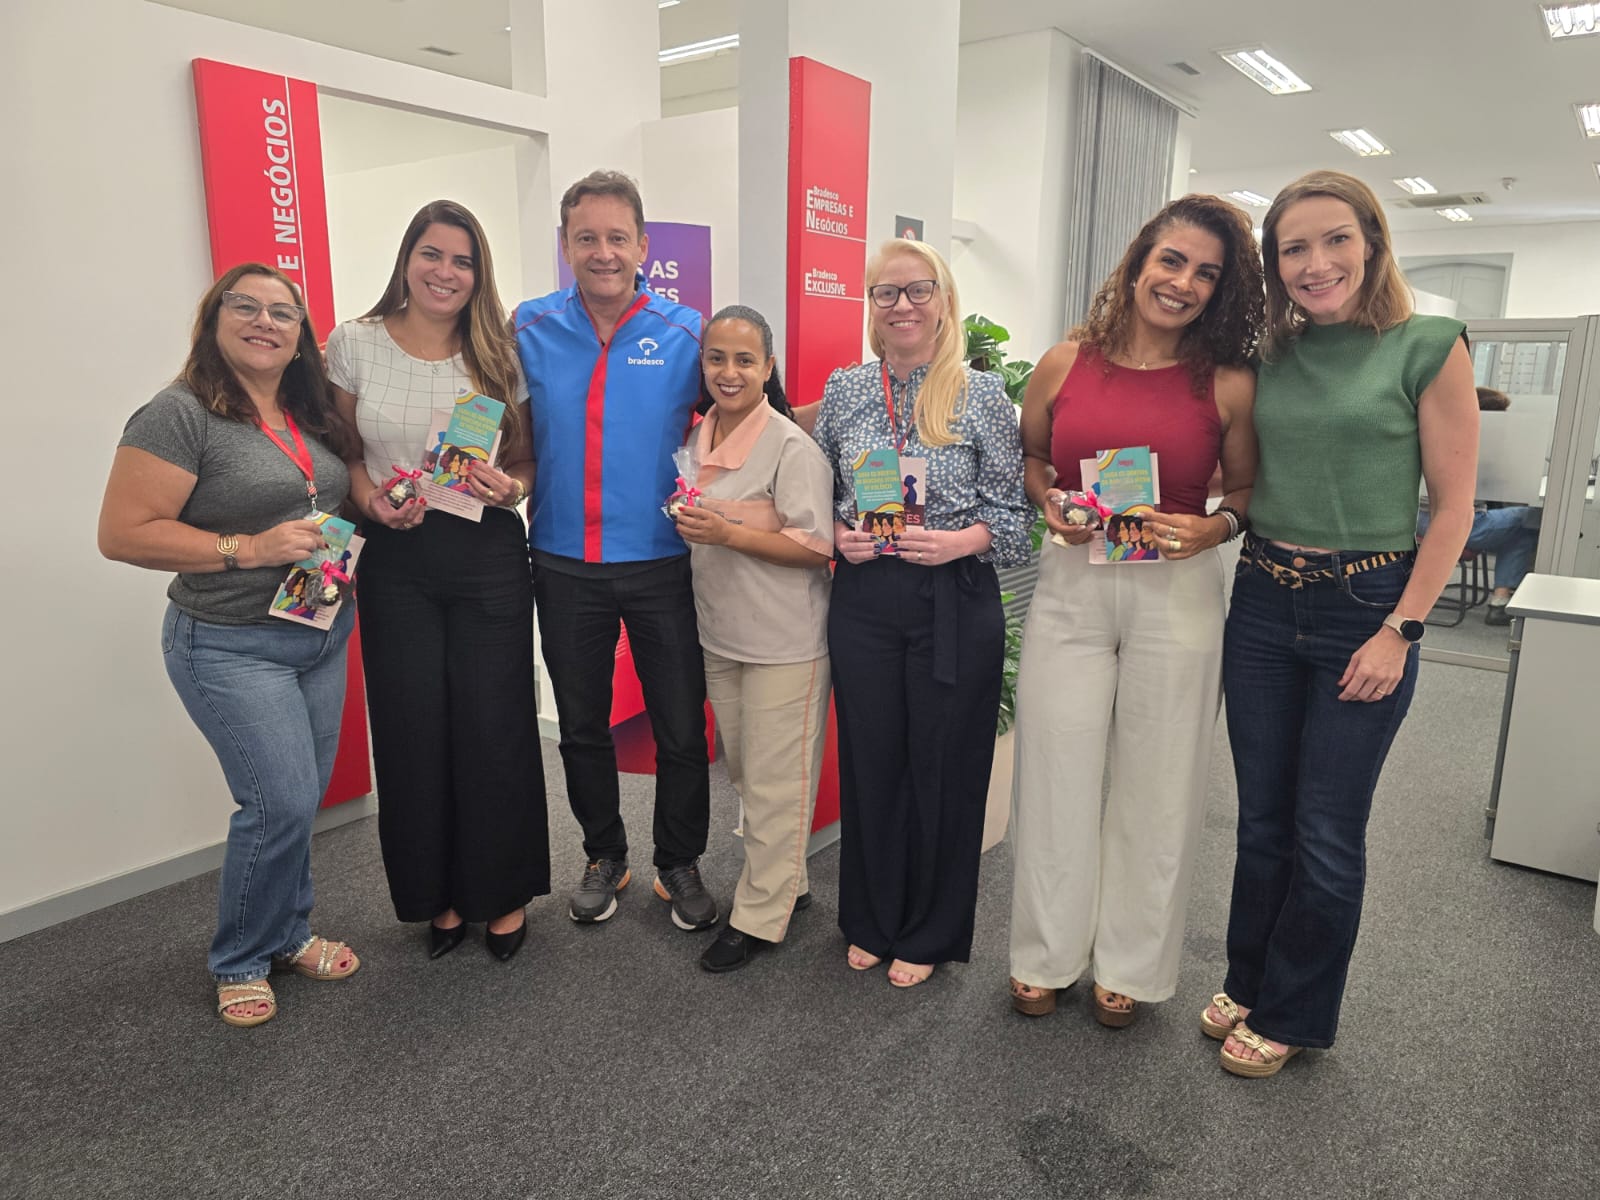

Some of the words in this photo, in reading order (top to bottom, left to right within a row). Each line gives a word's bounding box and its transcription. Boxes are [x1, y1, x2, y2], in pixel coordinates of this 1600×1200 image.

[262, 98, 298, 243] NEGÓCIOS
[813, 186, 839, 200] Bradesco
[806, 188, 847, 216] EMPRESAS
[849, 205, 854, 218] E
[278, 255, 299, 270] E
[649, 259, 679, 279] AS
[812, 266, 838, 280] Bradesco
[805, 272, 846, 296] EXCLUSIVE
[627, 356, 665, 366] bradesco
